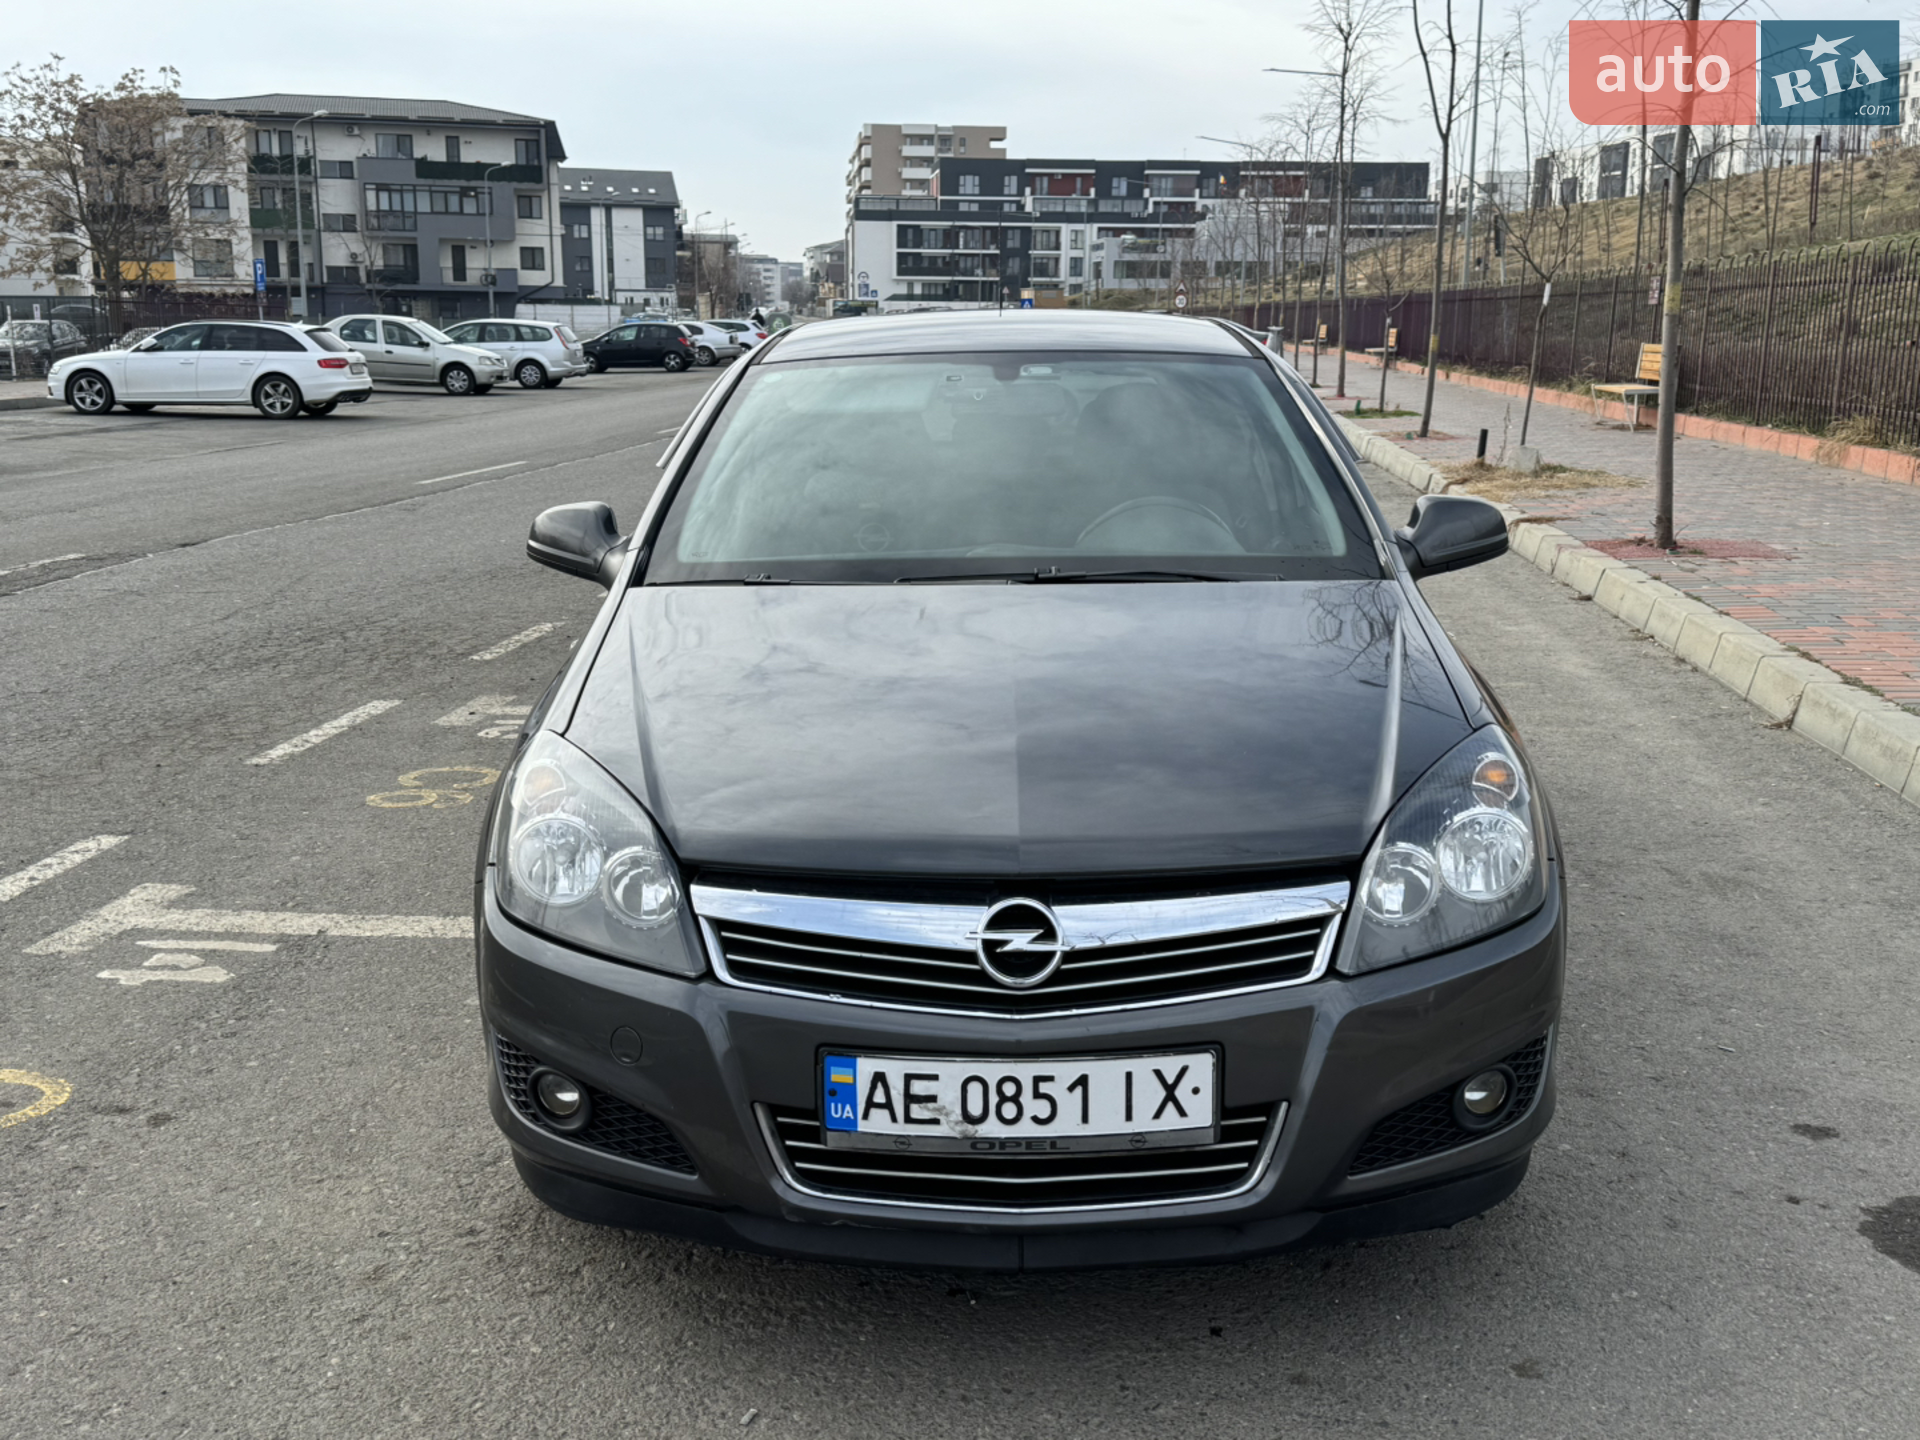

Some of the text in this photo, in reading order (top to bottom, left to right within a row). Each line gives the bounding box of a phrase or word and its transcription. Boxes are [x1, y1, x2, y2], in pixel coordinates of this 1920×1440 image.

[255, 263, 263, 282] P
[861, 1064, 1190, 1126] AE 0851 IX
[830, 1102, 855, 1120] UA
[969, 1139, 1071, 1152] OPEL
